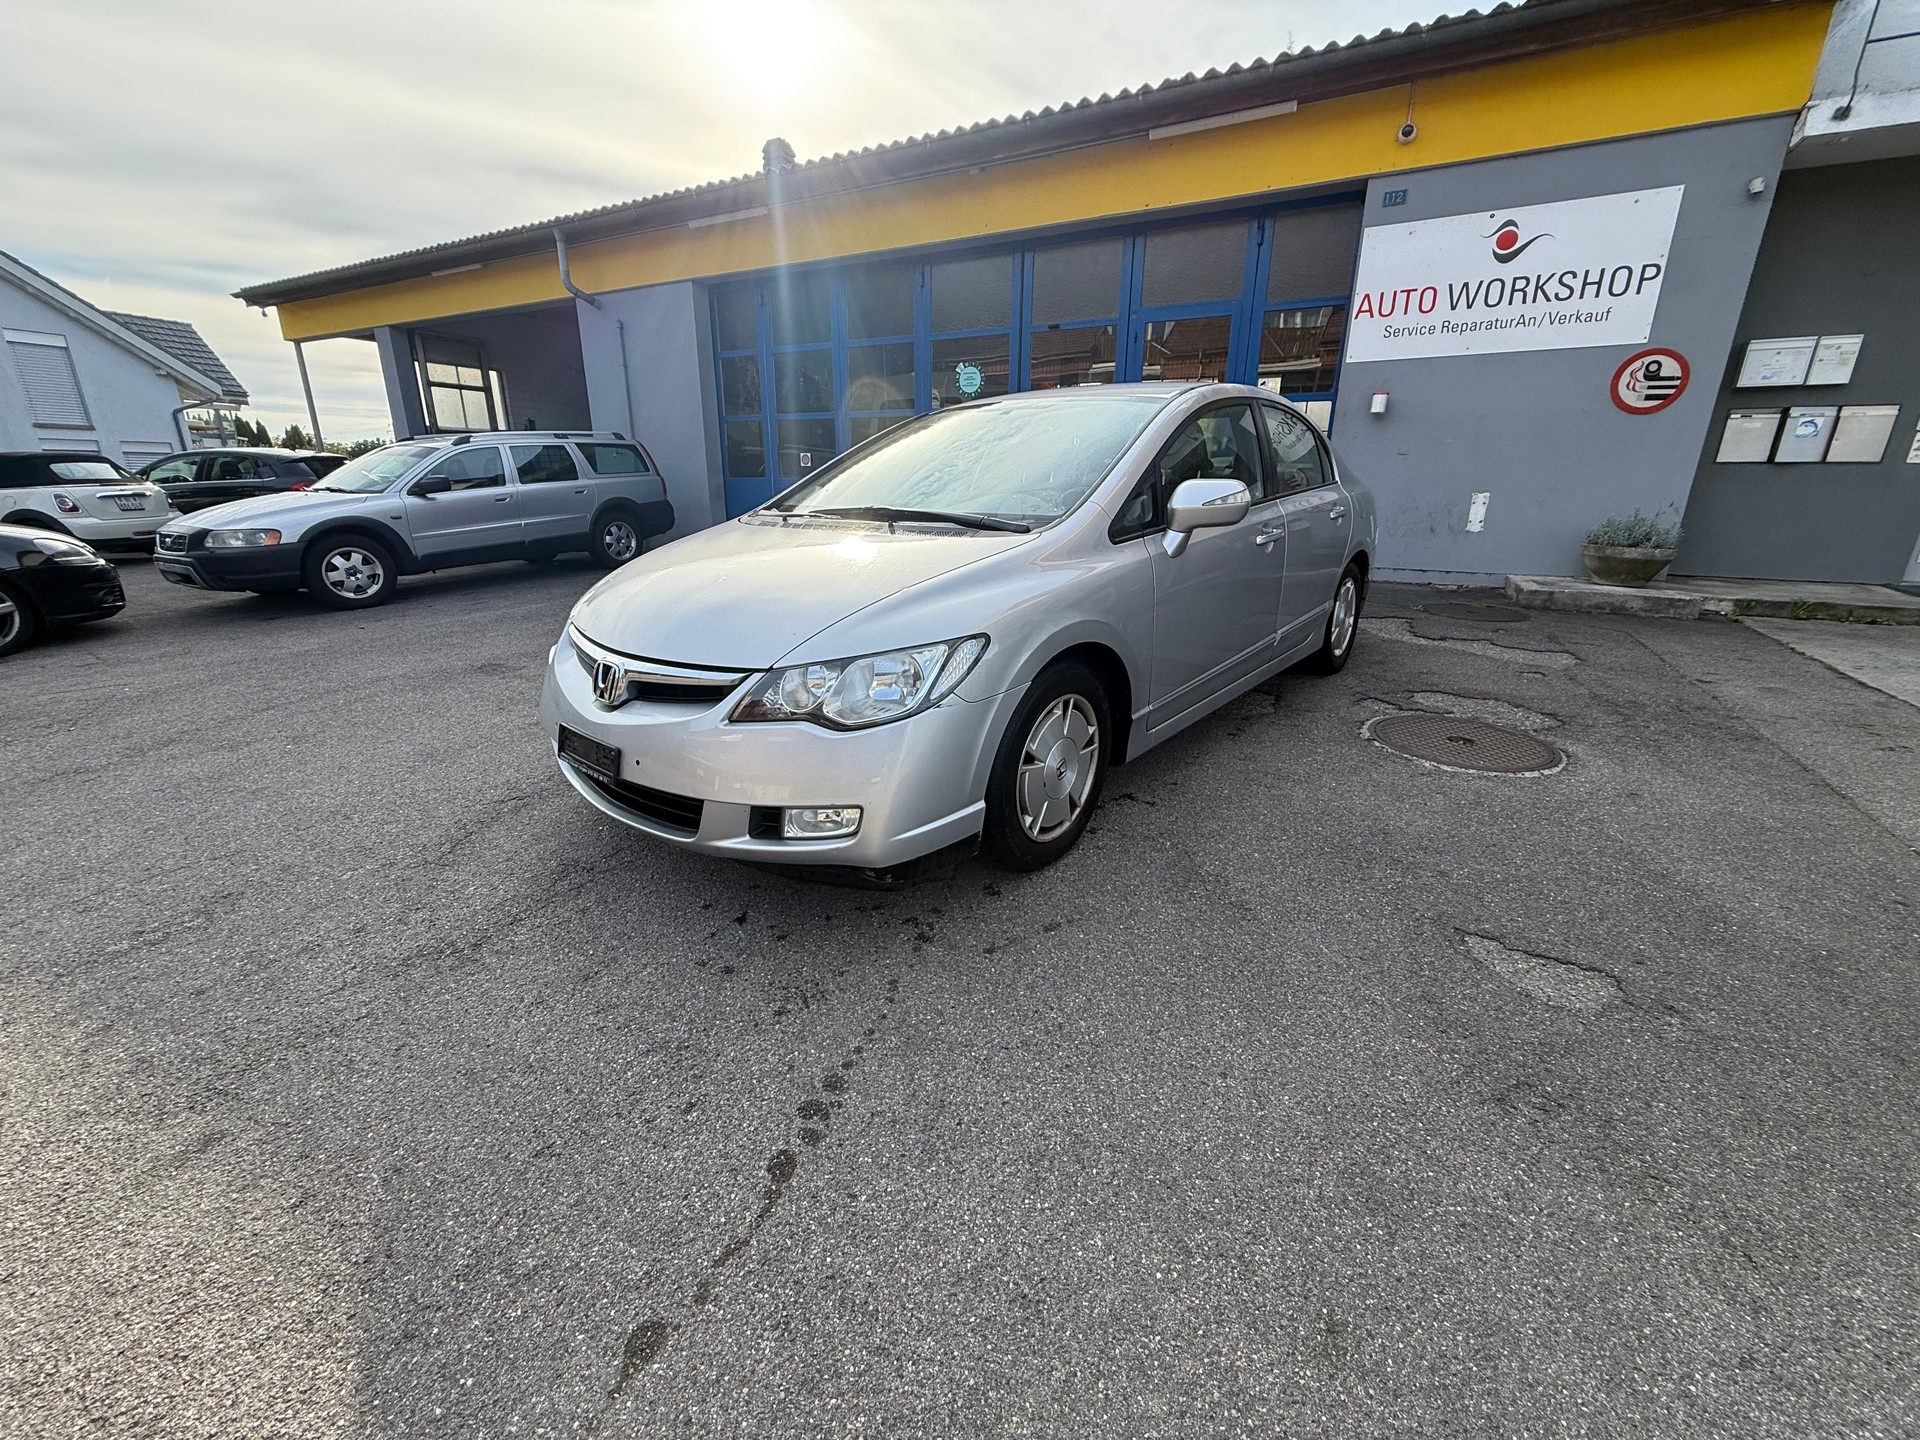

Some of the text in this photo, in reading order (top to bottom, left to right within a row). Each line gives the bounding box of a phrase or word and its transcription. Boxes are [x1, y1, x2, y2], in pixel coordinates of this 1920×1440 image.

[1385, 191, 1404, 204] 112
[1354, 263, 1662, 320] AUTO WORKSHOP
[1383, 306, 1613, 339] Service ReparaturAn/Verkauf
